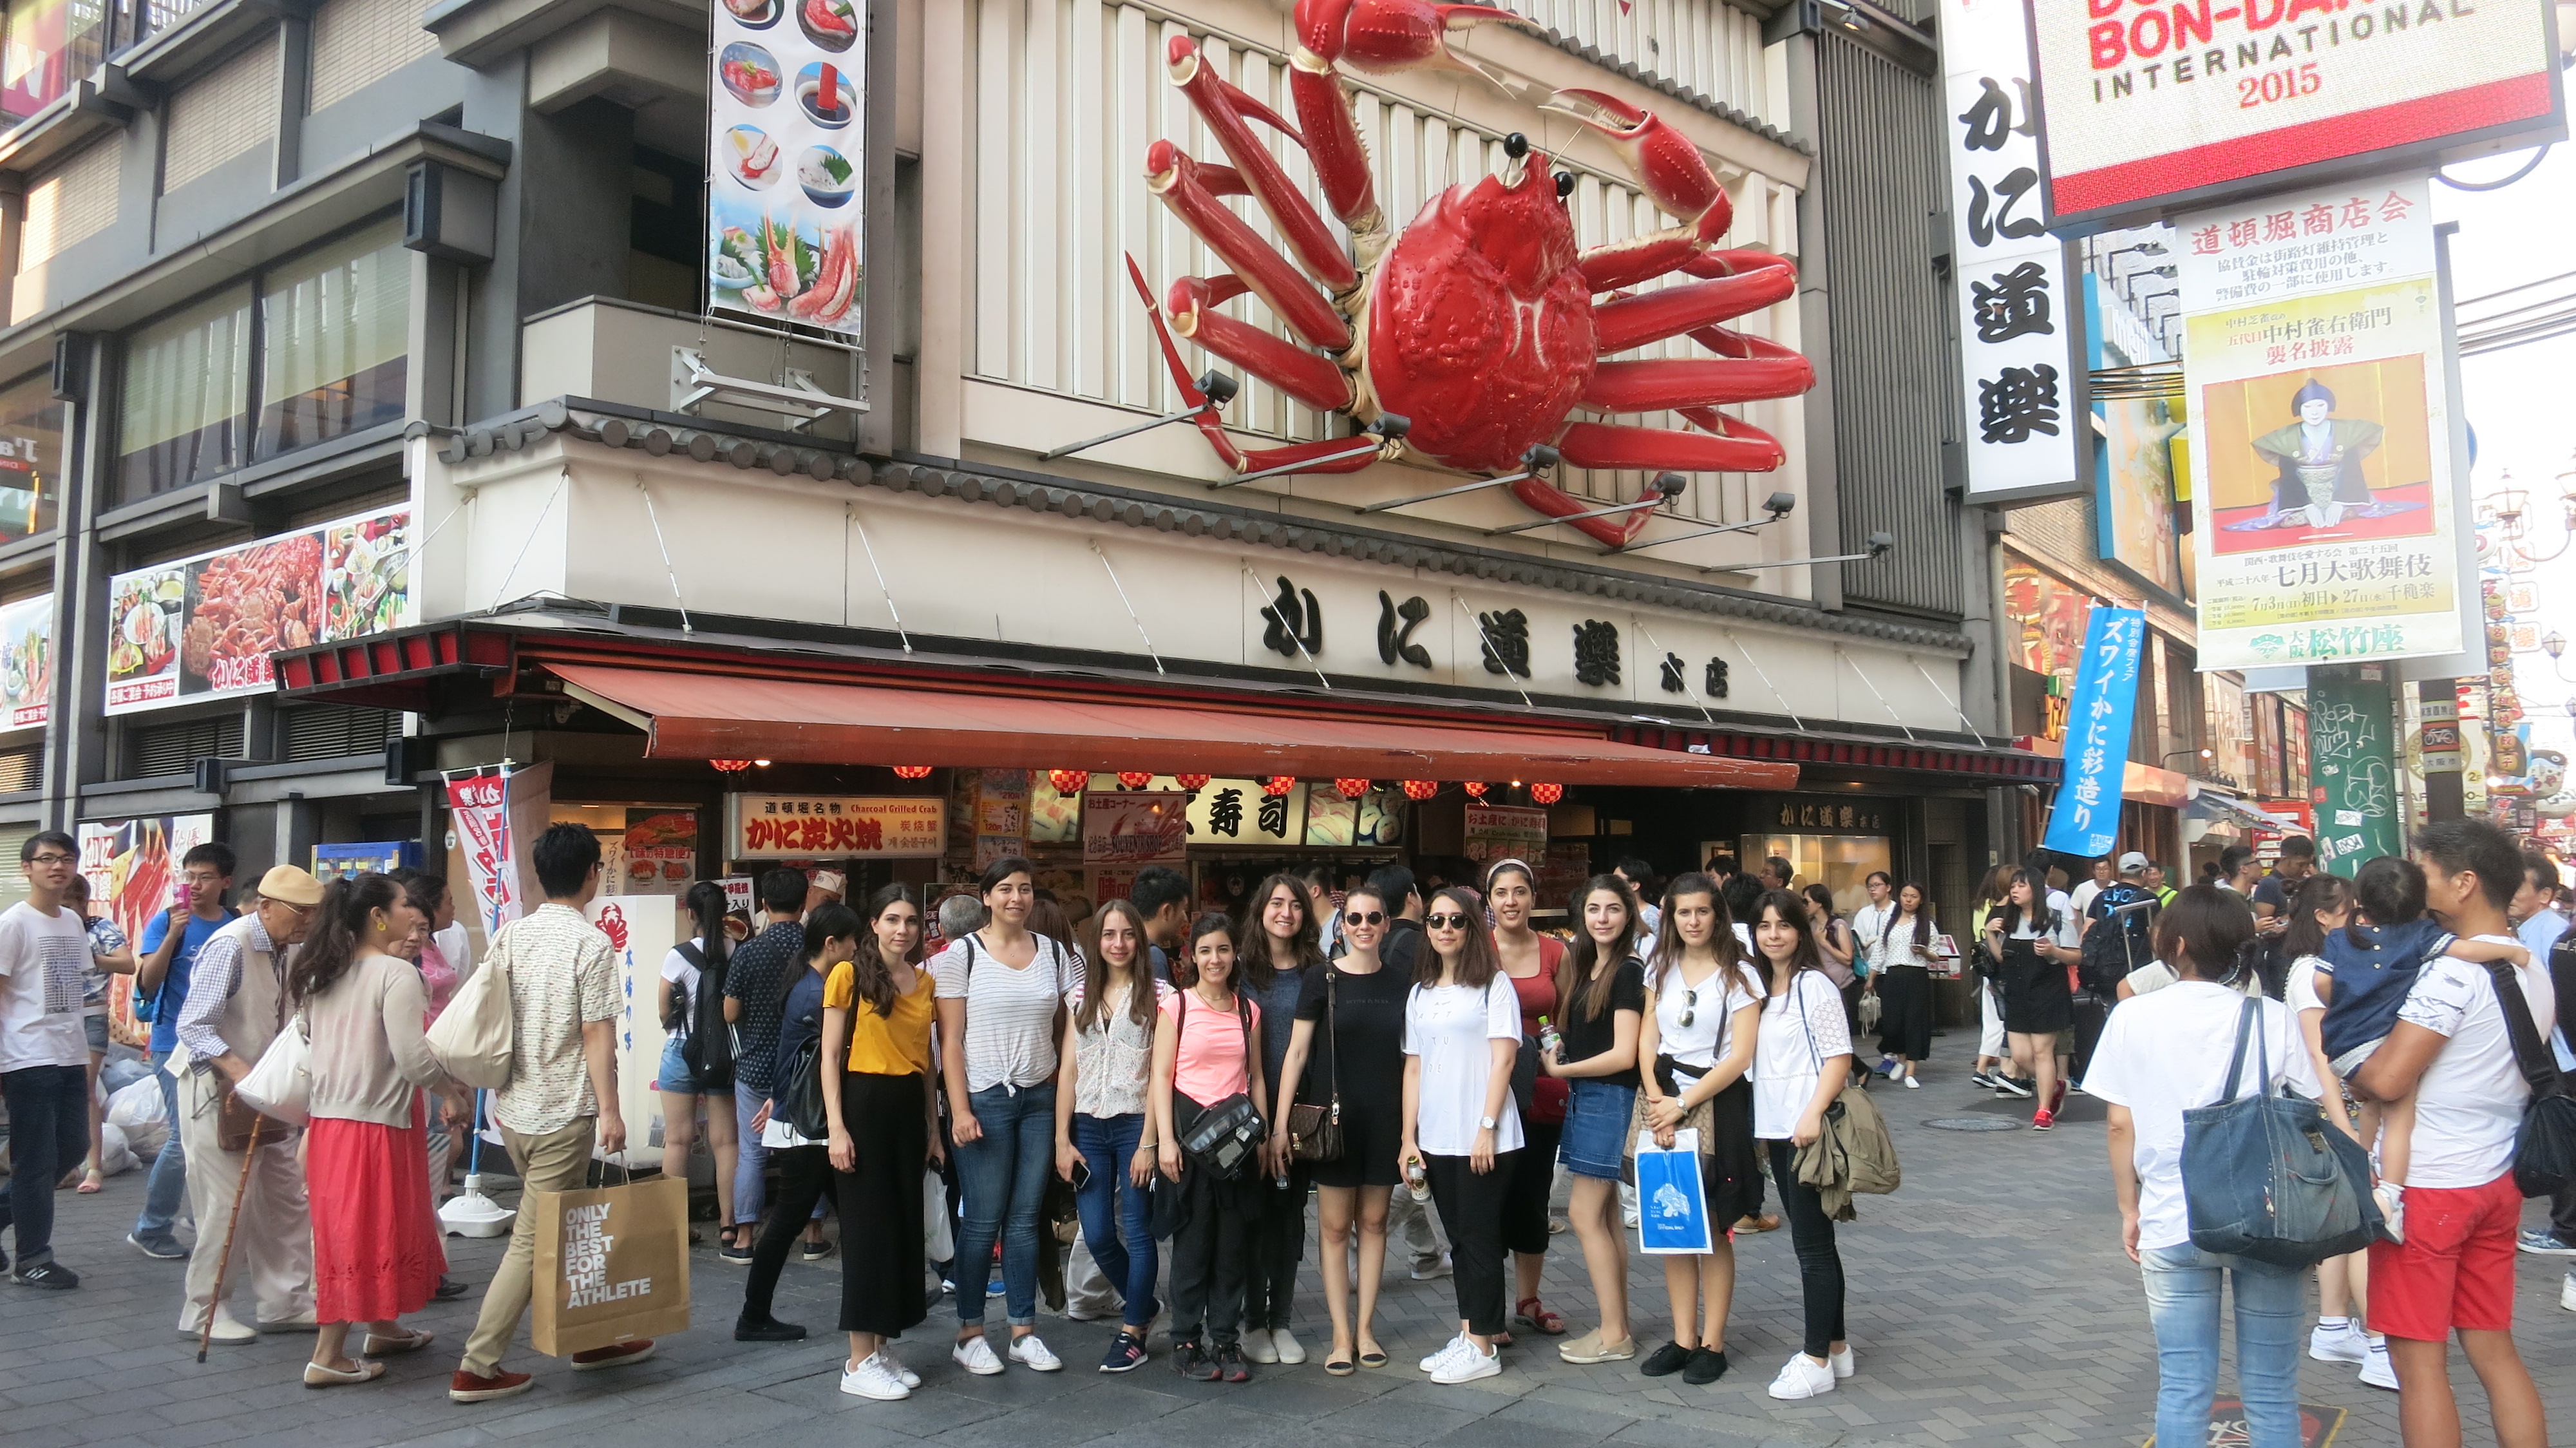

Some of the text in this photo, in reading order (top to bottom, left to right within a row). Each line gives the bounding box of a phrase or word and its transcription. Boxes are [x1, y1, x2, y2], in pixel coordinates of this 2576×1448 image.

[2093, 0, 2474, 102] INTERNATIONAL
[2238, 62, 2320, 110] 2015
[2190, 190, 2415, 256] 道頓堀商店会
[2265, 335, 2354, 365] 襲名披露
[2271, 554, 2432, 587] 七月大歌舞伎
[2306, 623, 2405, 658] 松竹座
[2073, 616, 2129, 833] ズワイかに彩造り
[764, 801, 842, 816] 道頓堀名物
[850, 804, 938, 814] Charcoal Grilled Crab
[1088, 797, 1136, 810] お土産コーナー
[745, 816, 883, 851] かに炭火焼
[605, 841, 619, 896] ズワイかに彩
[565, 1202, 612, 1224] ONLY
[565, 1221, 602, 1242] THE
[565, 1235, 614, 1257] BEST
[565, 1253, 607, 1276] FOR
[566, 1270, 607, 1291] THE
[566, 1277, 651, 1310] ATHLETE
